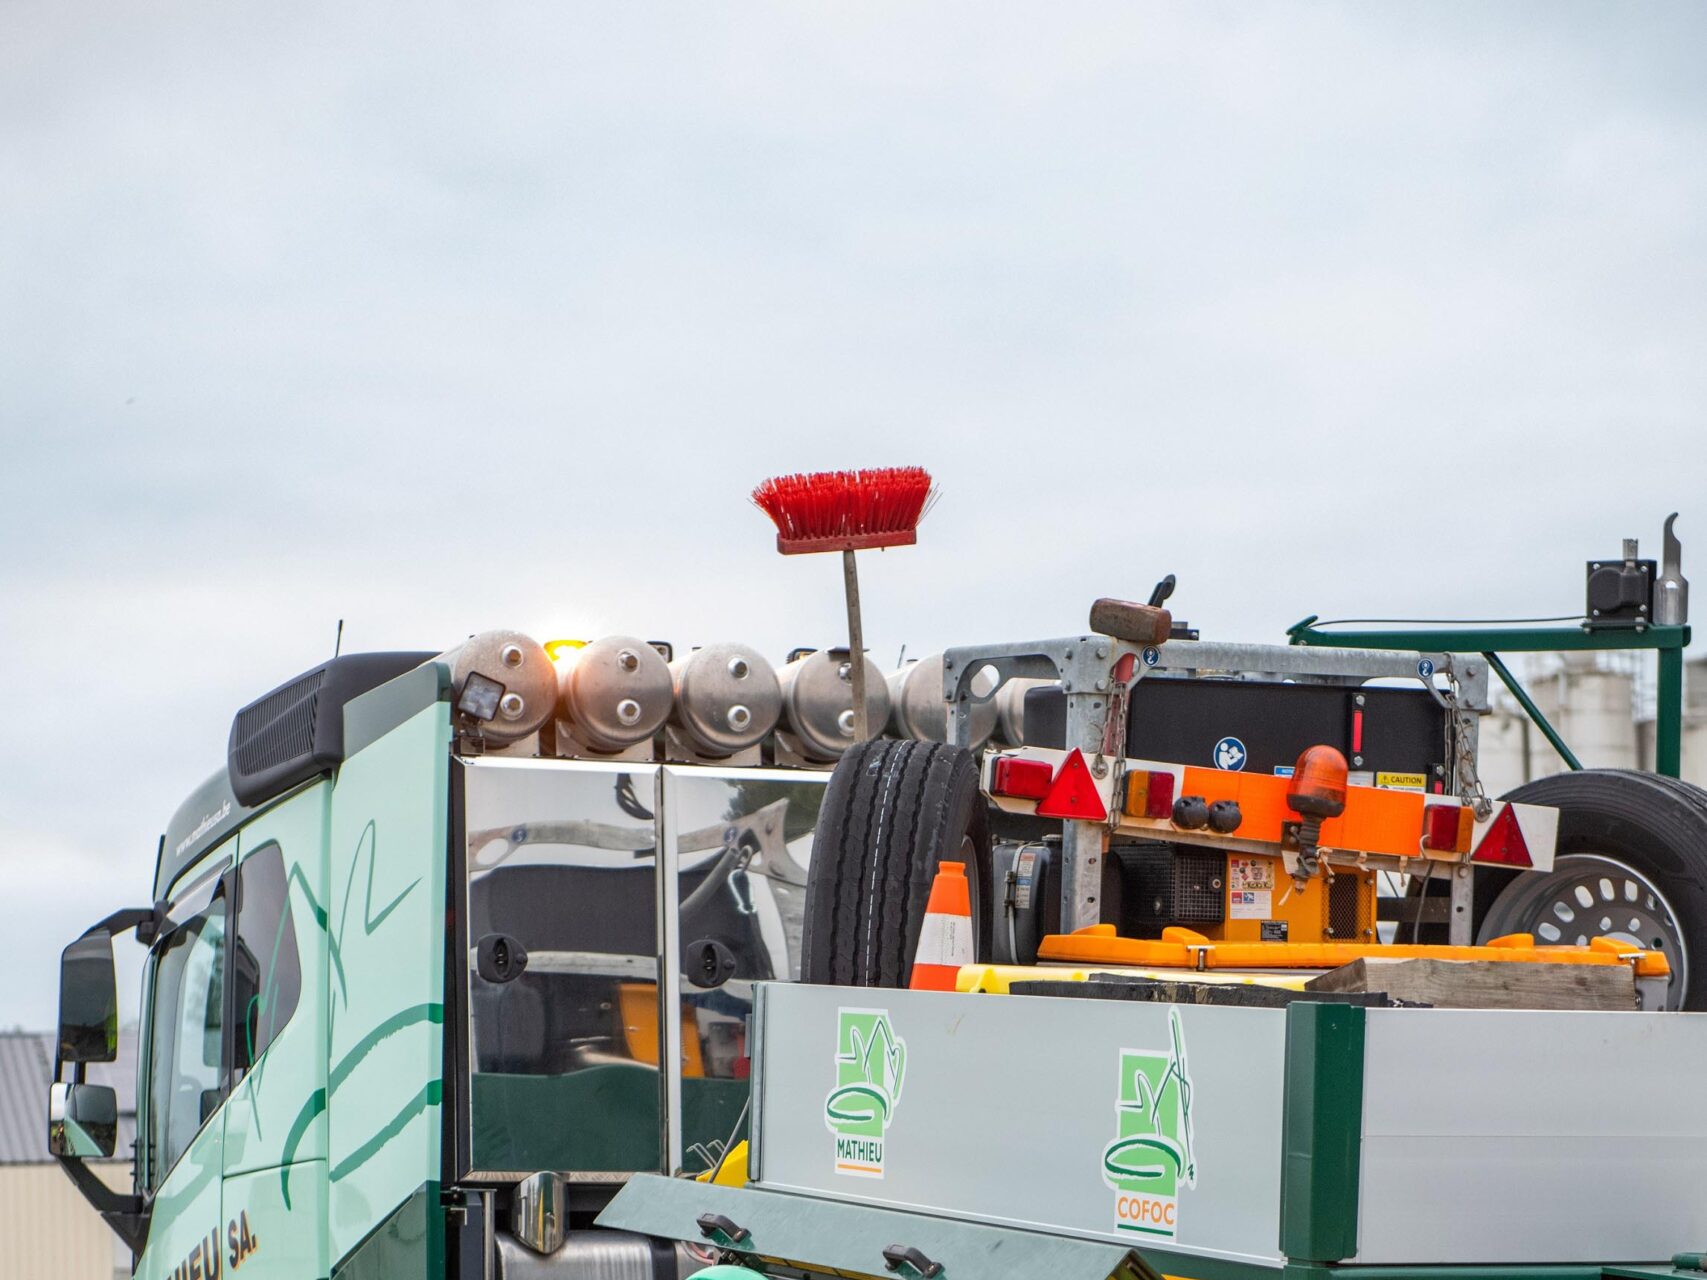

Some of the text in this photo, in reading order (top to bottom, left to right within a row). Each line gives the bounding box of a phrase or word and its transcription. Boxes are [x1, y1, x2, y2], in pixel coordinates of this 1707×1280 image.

[1390, 775, 1422, 784] CAUTION
[837, 1138, 882, 1163] MATHIEU
[1118, 1196, 1175, 1226] COFOC
